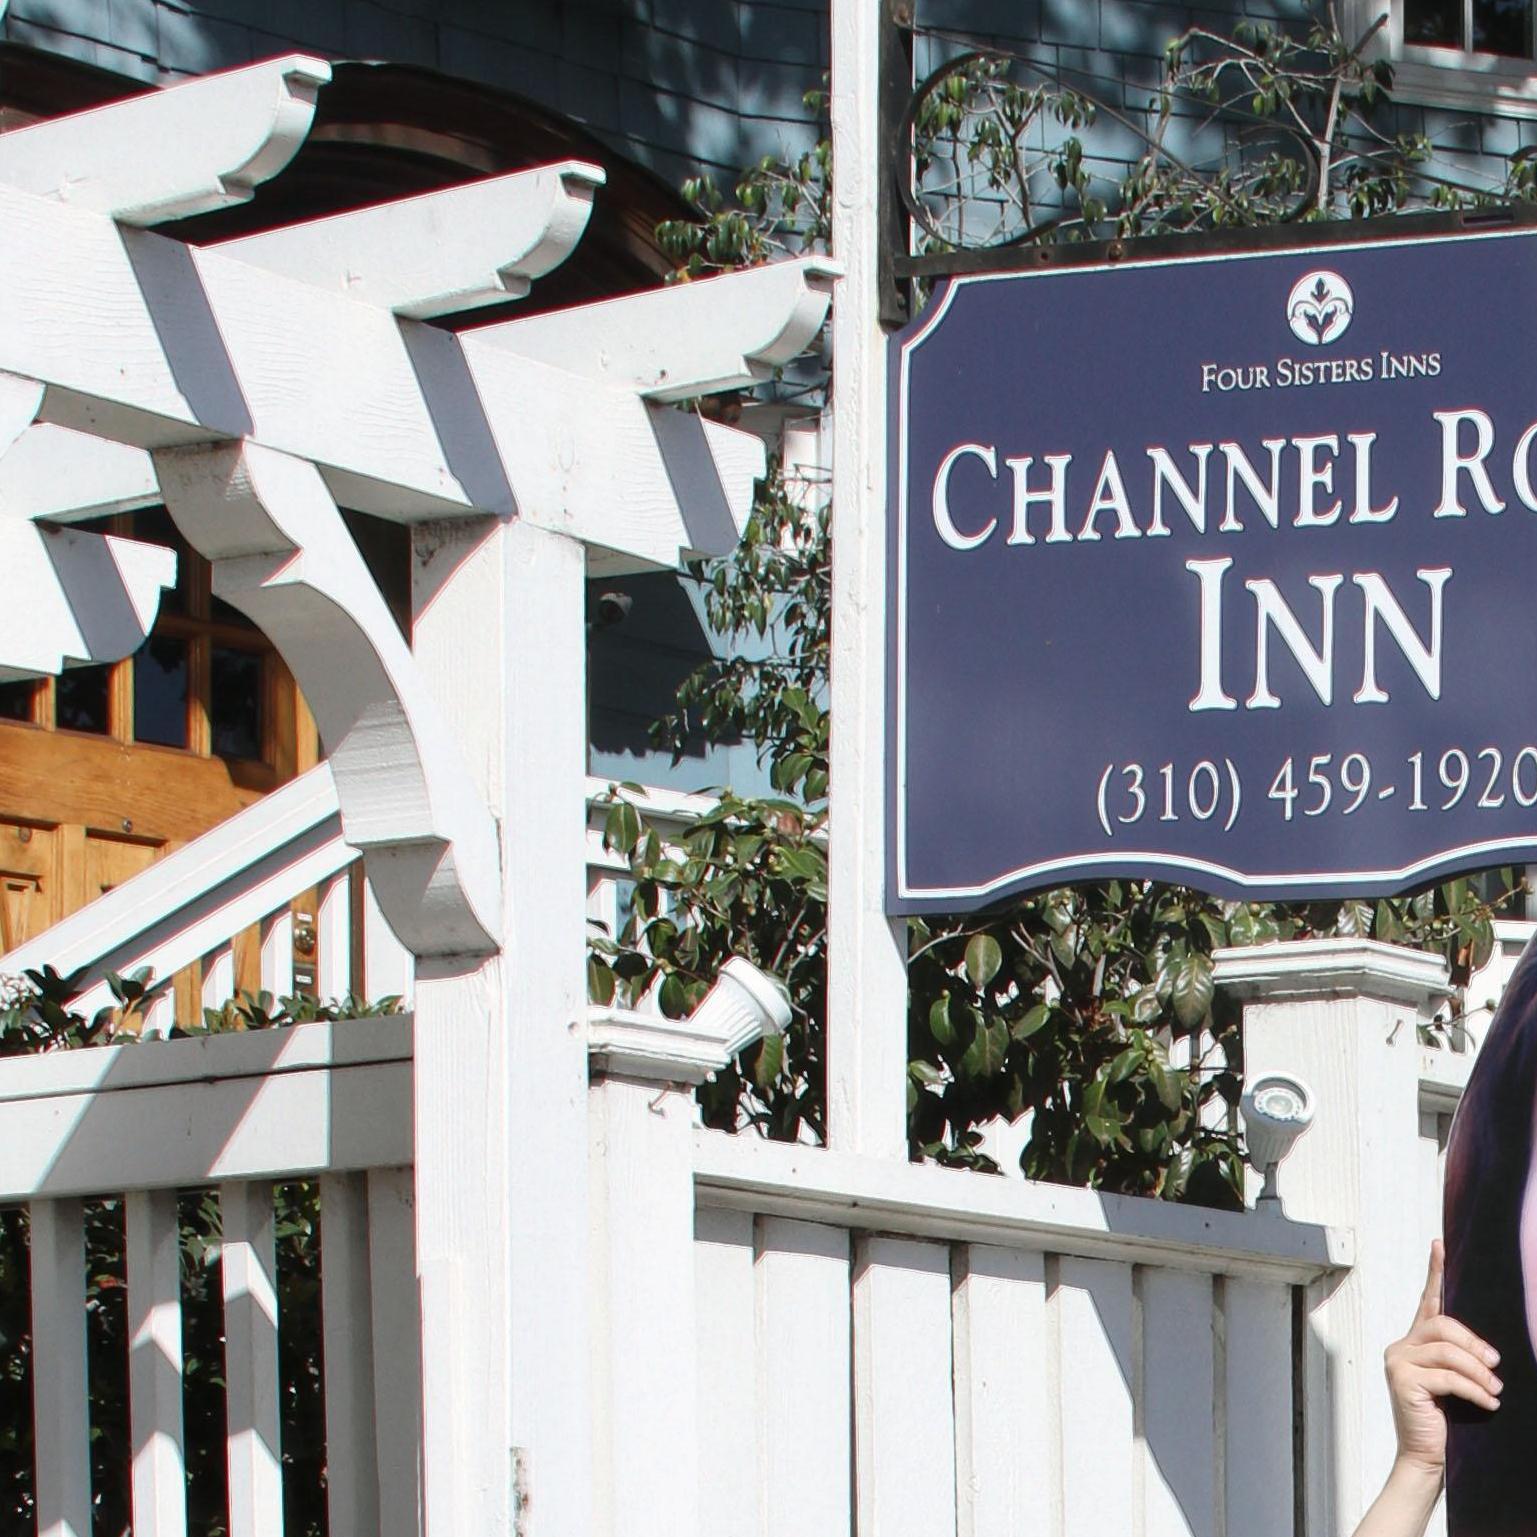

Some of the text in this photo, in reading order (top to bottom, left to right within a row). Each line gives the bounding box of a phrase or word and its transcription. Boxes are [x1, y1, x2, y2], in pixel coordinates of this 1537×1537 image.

[1201, 351, 1441, 392] FOUR SISTERS INNS
[932, 432, 1399, 551] CHANNEL
[1185, 557, 1453, 711] INN
[1096, 757, 1241, 836] (310)
